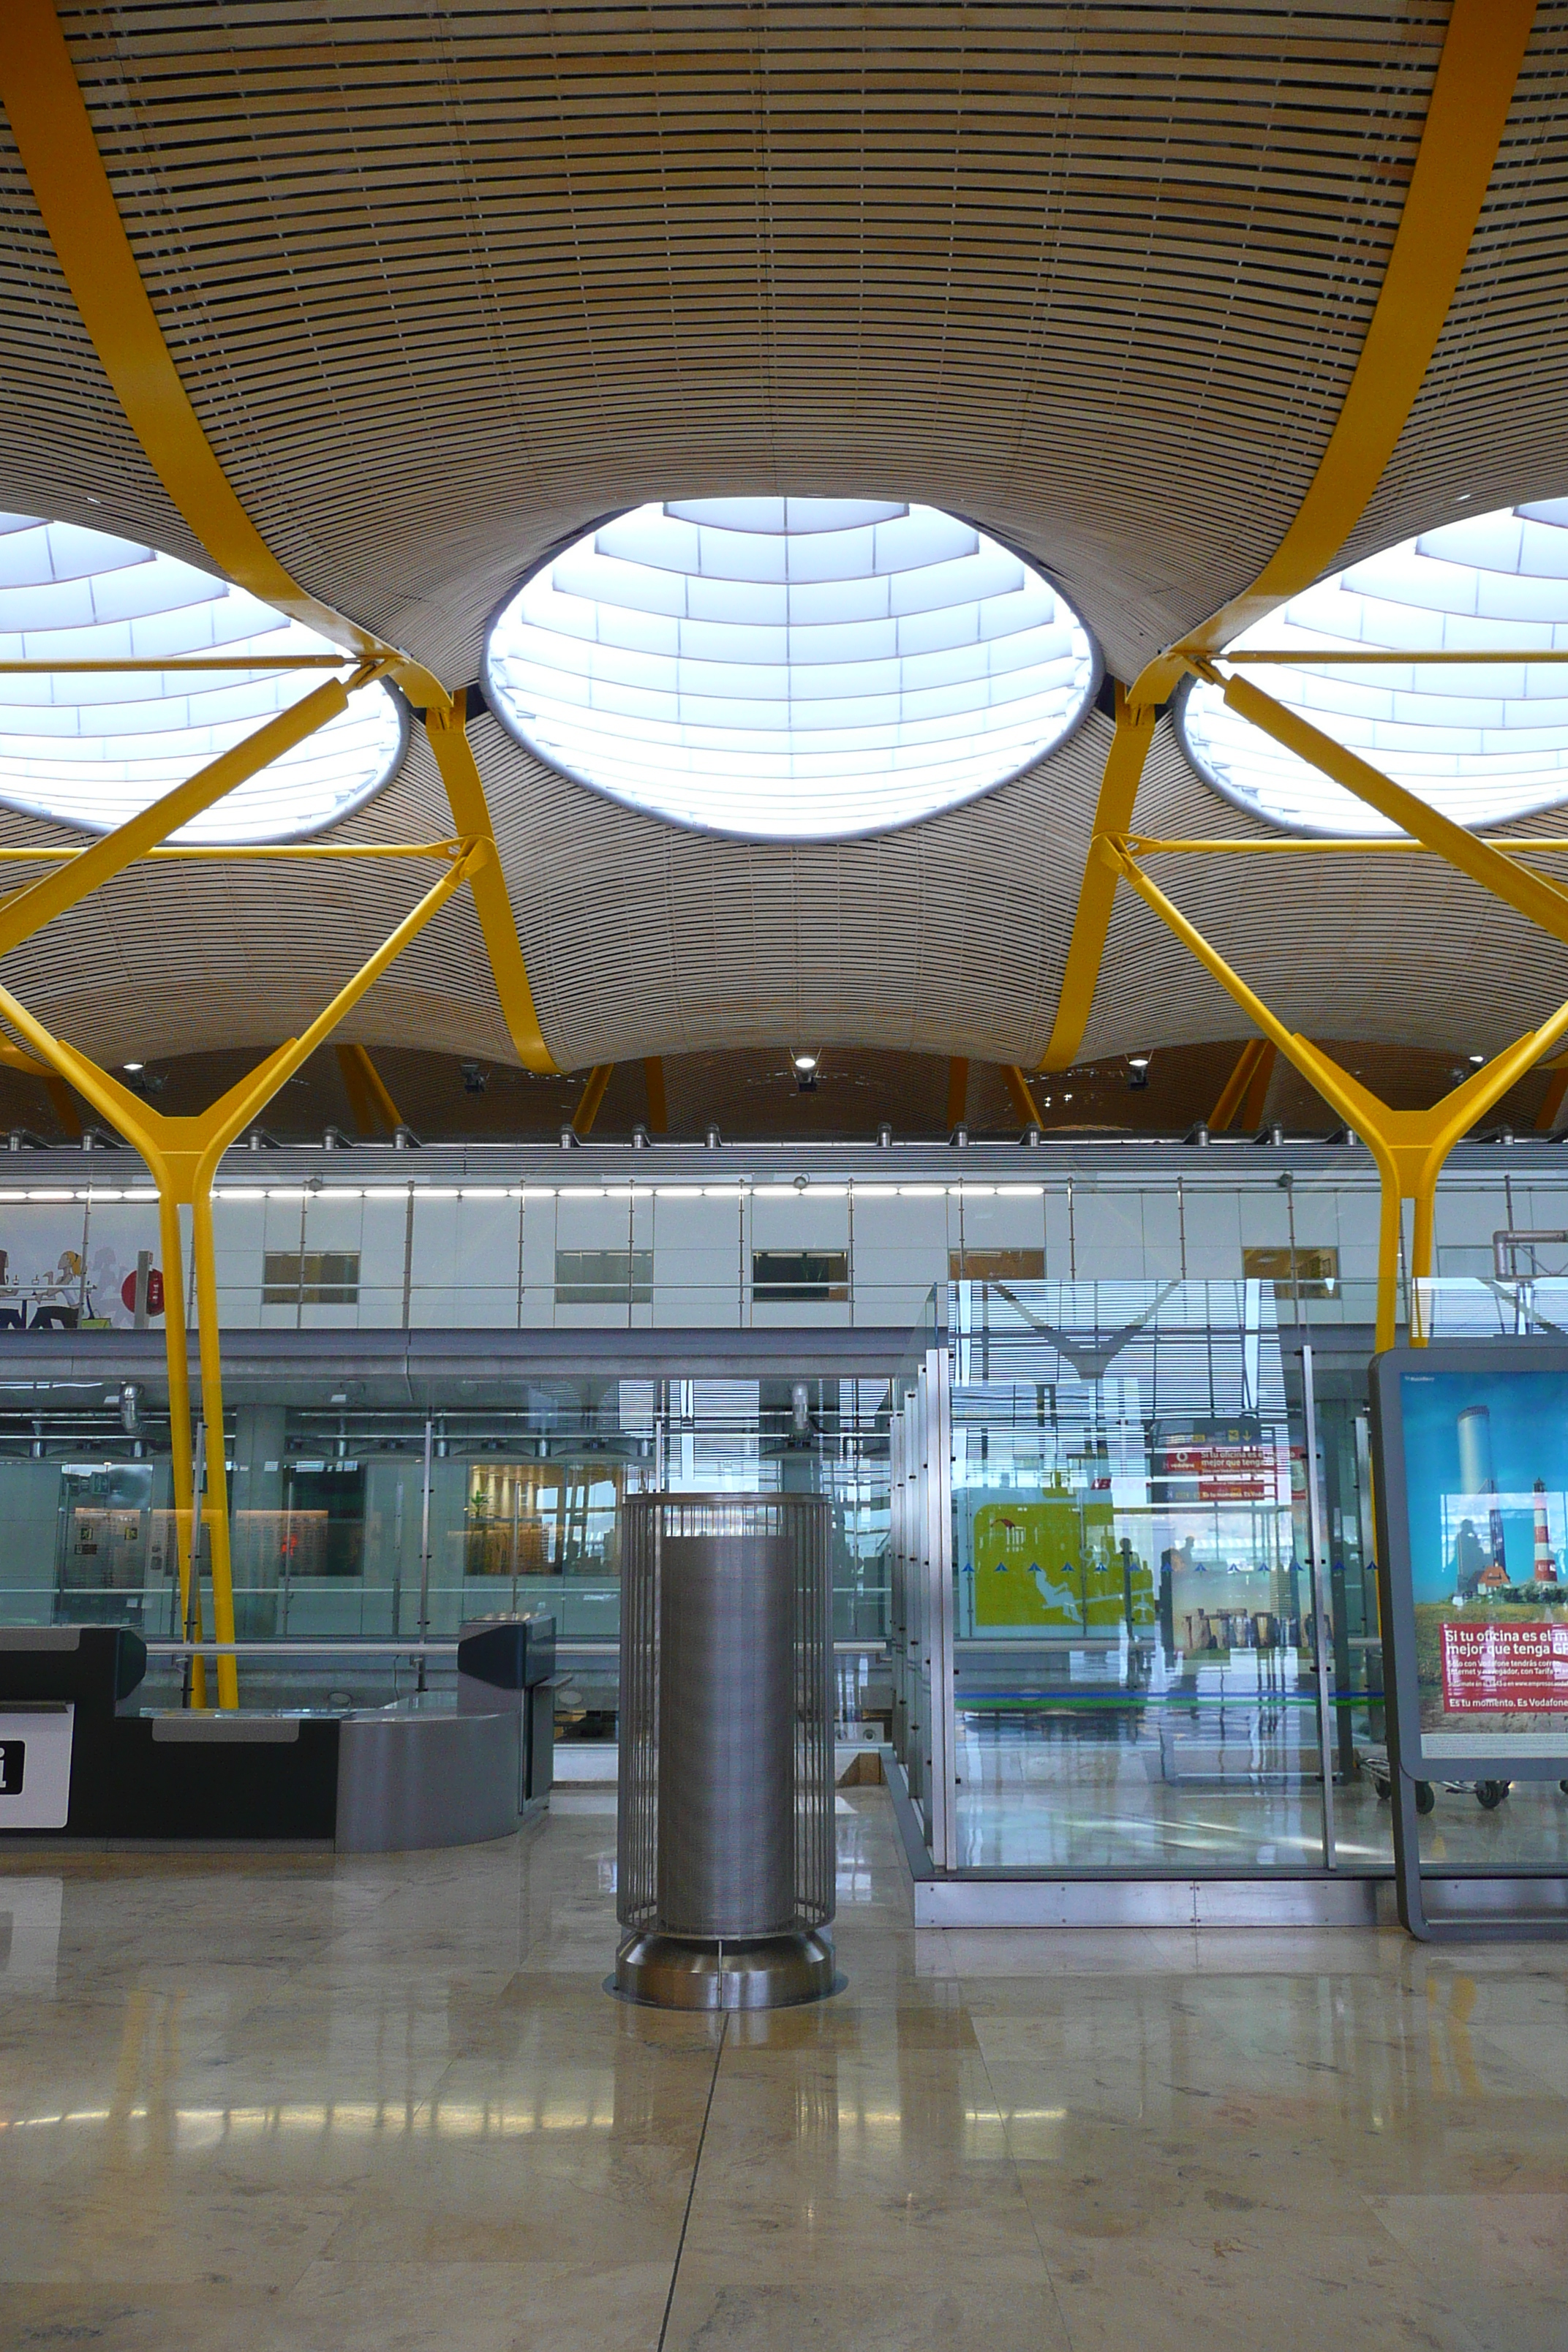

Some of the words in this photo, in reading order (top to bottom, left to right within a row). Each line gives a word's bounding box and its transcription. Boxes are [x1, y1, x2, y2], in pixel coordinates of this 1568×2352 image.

[1201, 1459, 1224, 1467] mejor
[1446, 1630, 1457, 1642] Si
[1460, 1631, 1474, 1642] tu
[1477, 1629, 1519, 1642] oficina
[1522, 1632, 1537, 1642] es
[1539, 1629, 1552, 1642] el
[1447, 1643, 1484, 1657] mejor
[1487, 1645, 1511, 1657] que
[1513, 1643, 1550, 1657] tenga
[1450, 1698, 1460, 1707] Es
[1461, 1698, 1471, 1707] tu
[1473, 1699, 1516, 1707] momento.
[1517, 1697, 1528, 1707] Es
